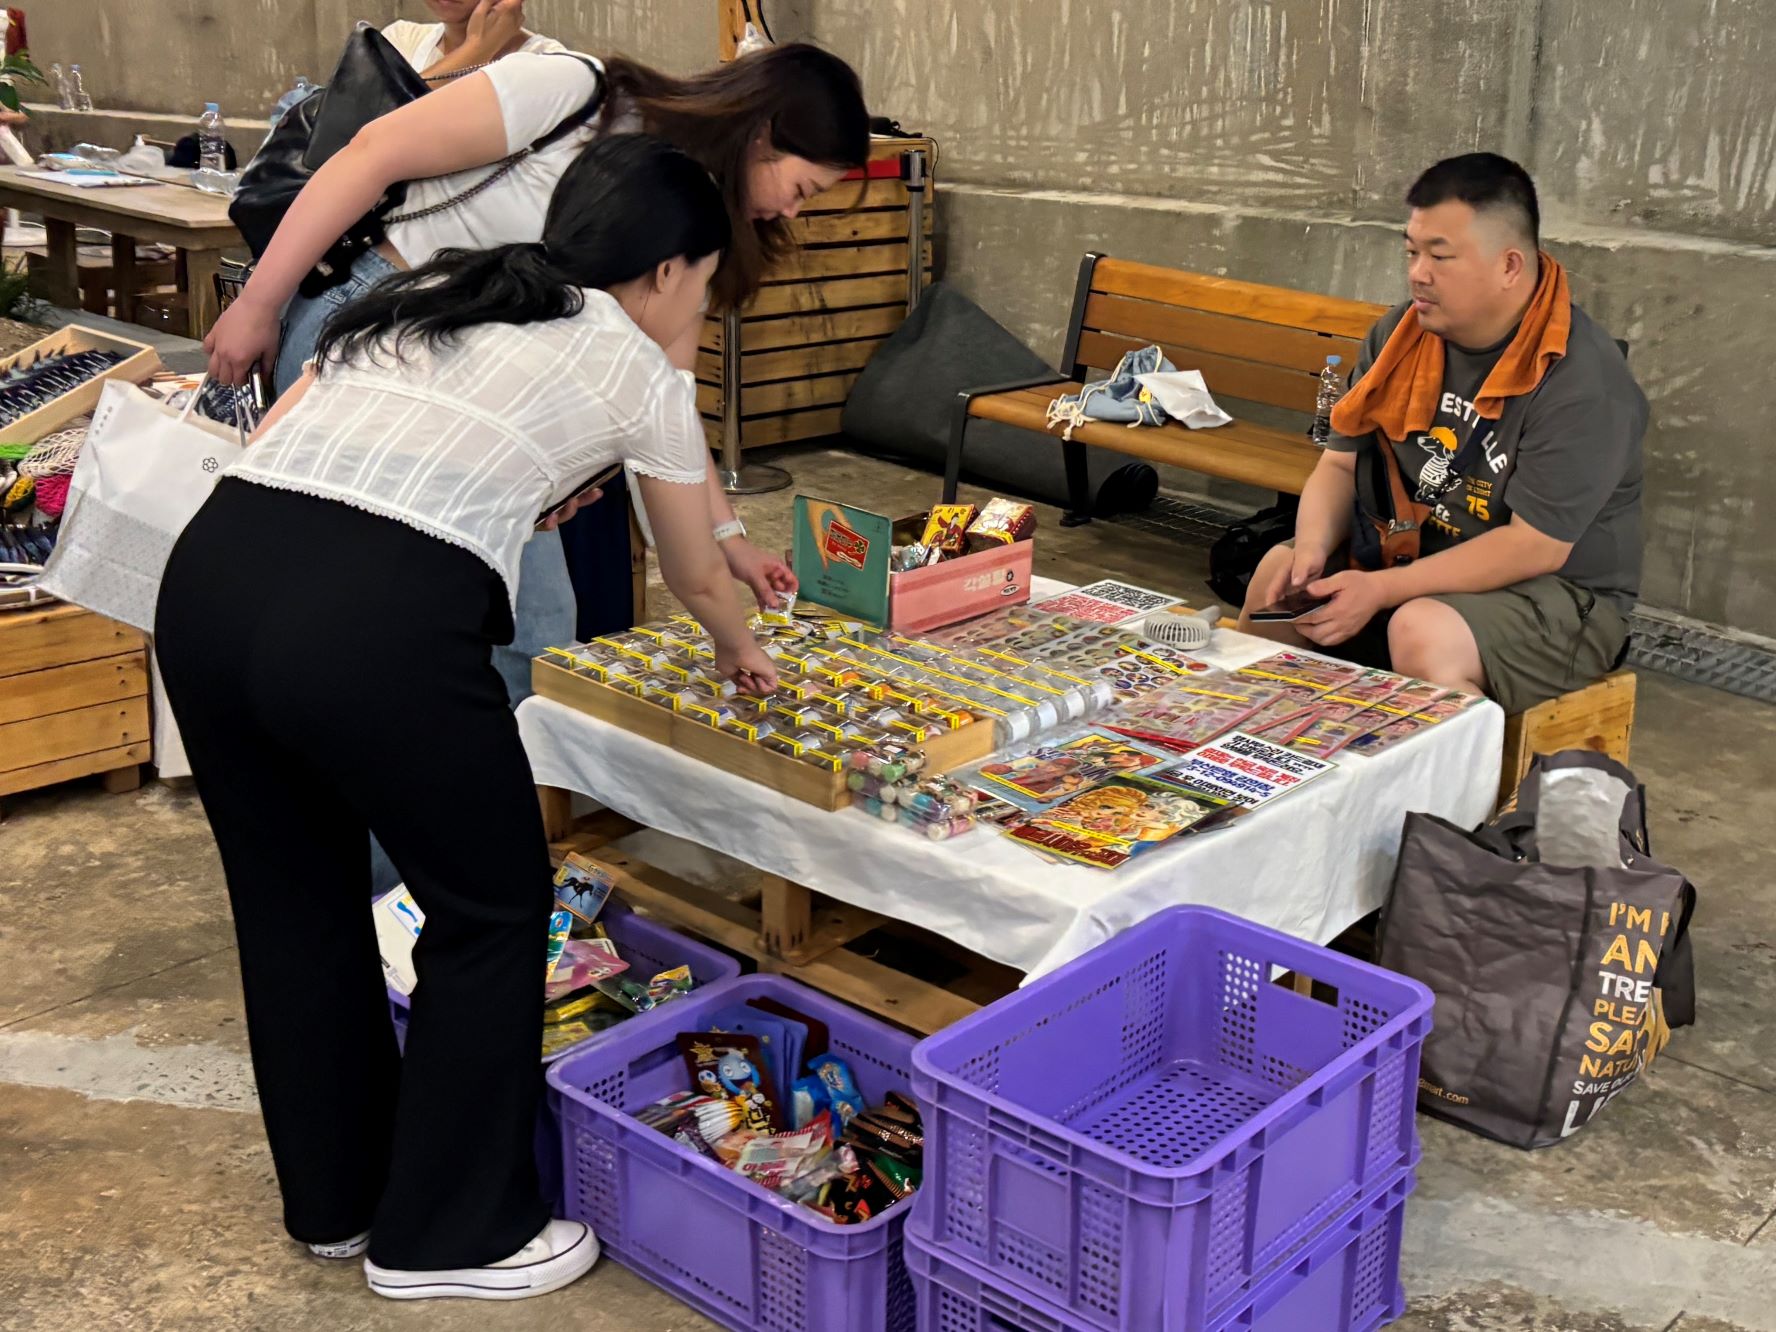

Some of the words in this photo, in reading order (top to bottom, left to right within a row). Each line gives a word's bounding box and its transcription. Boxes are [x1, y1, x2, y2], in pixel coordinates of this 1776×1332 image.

[1466, 495, 1490, 521] 75
[1609, 902, 1652, 933] I'M
[1572, 1080, 1611, 1095] SAVE
